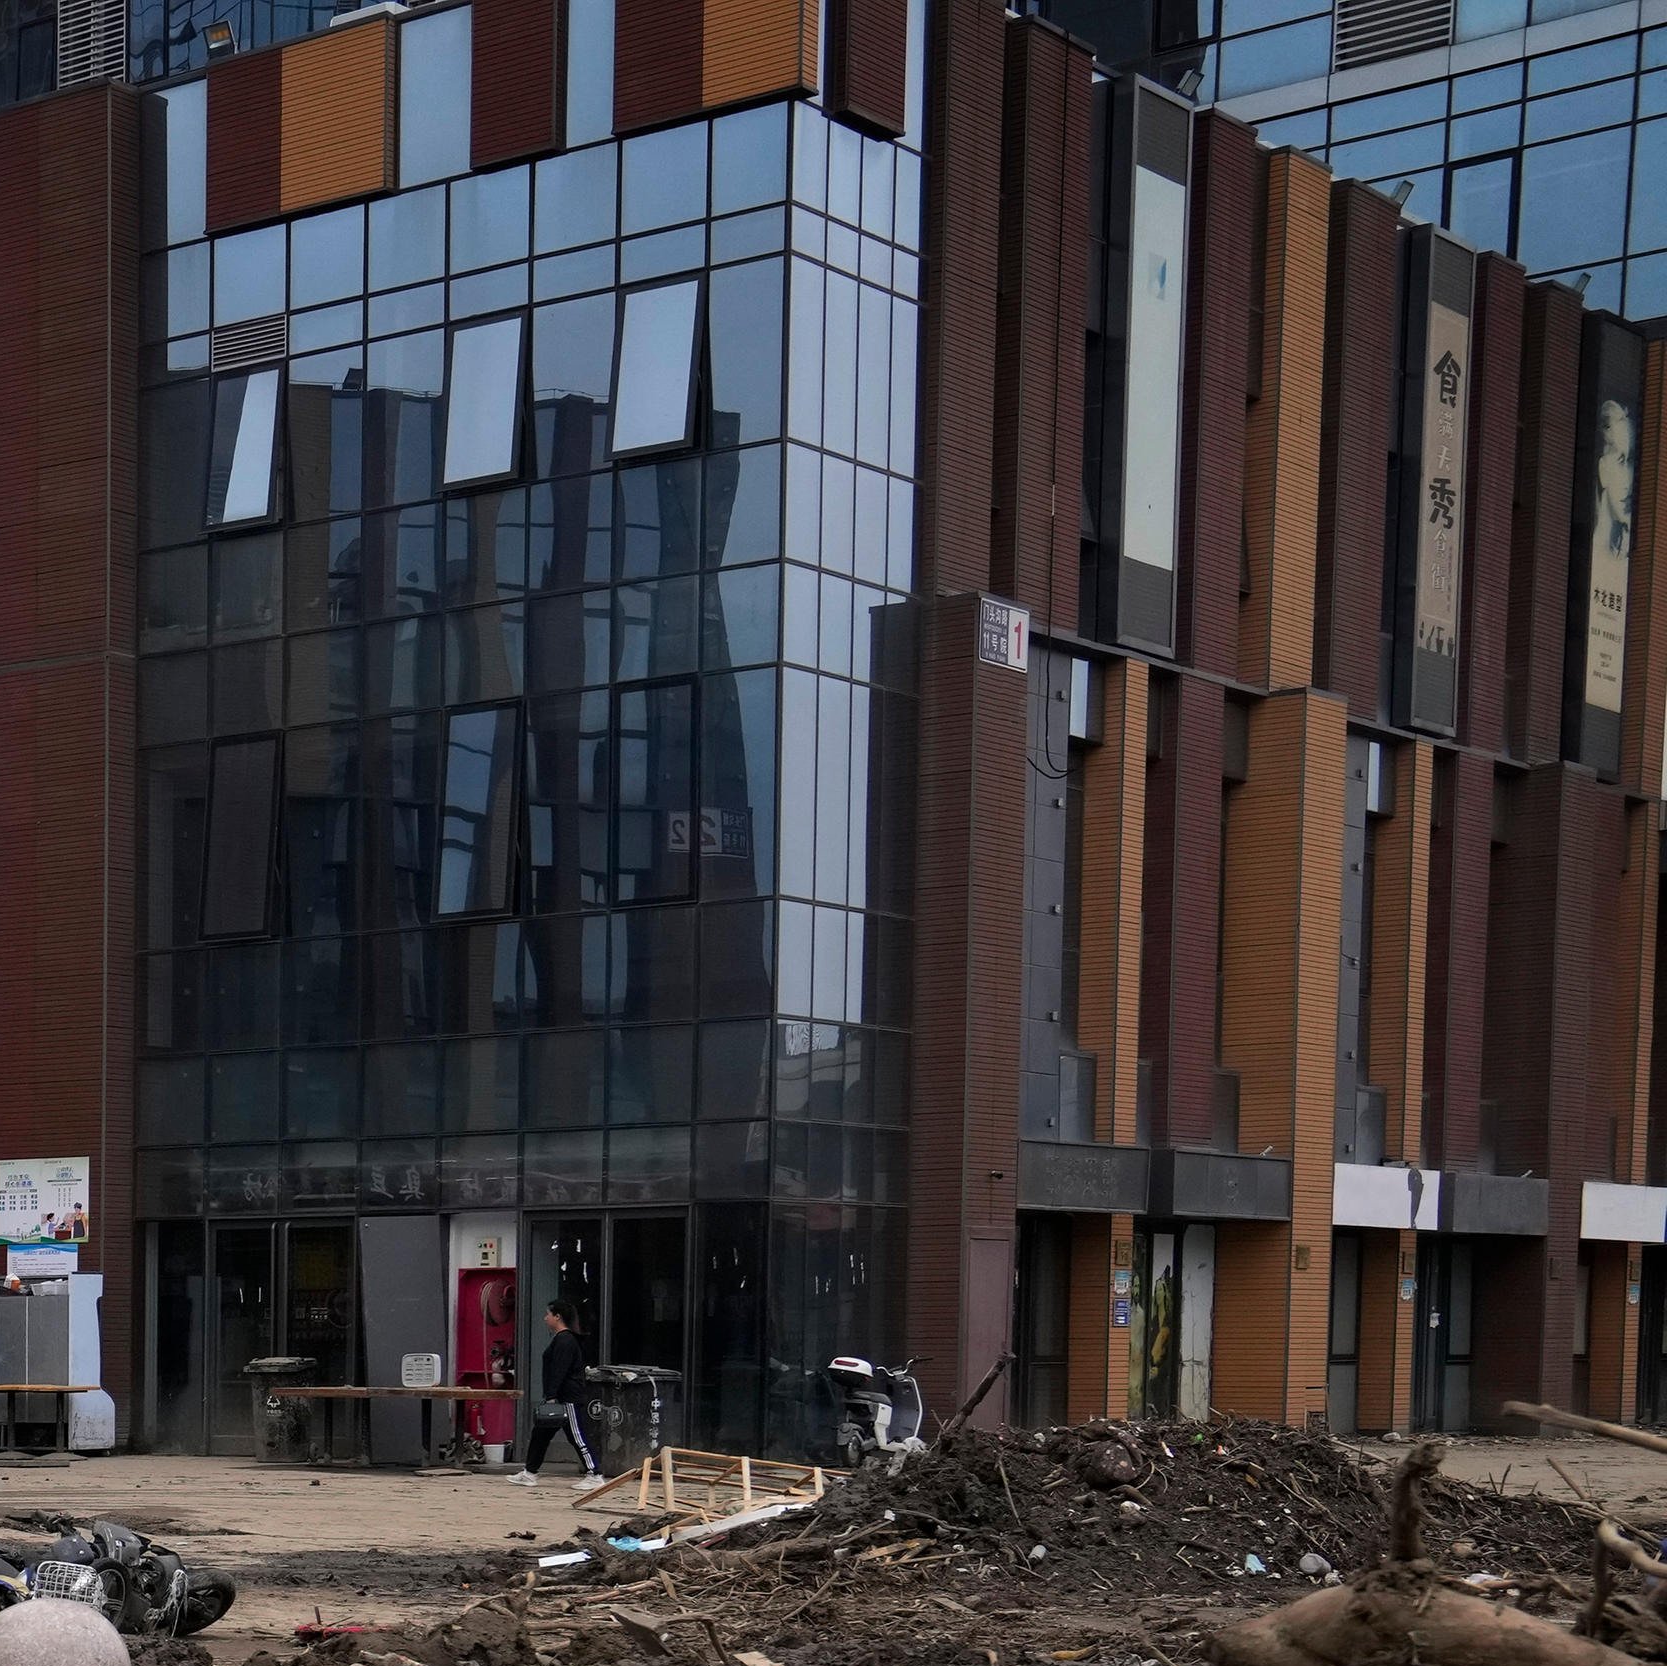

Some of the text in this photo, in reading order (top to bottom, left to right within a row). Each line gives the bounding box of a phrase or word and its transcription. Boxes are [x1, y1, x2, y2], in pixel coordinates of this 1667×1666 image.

[983, 603, 1008, 626] 门头沟路
[983, 632, 1008, 655] 11号院
[1014, 620, 1022, 660] 1
